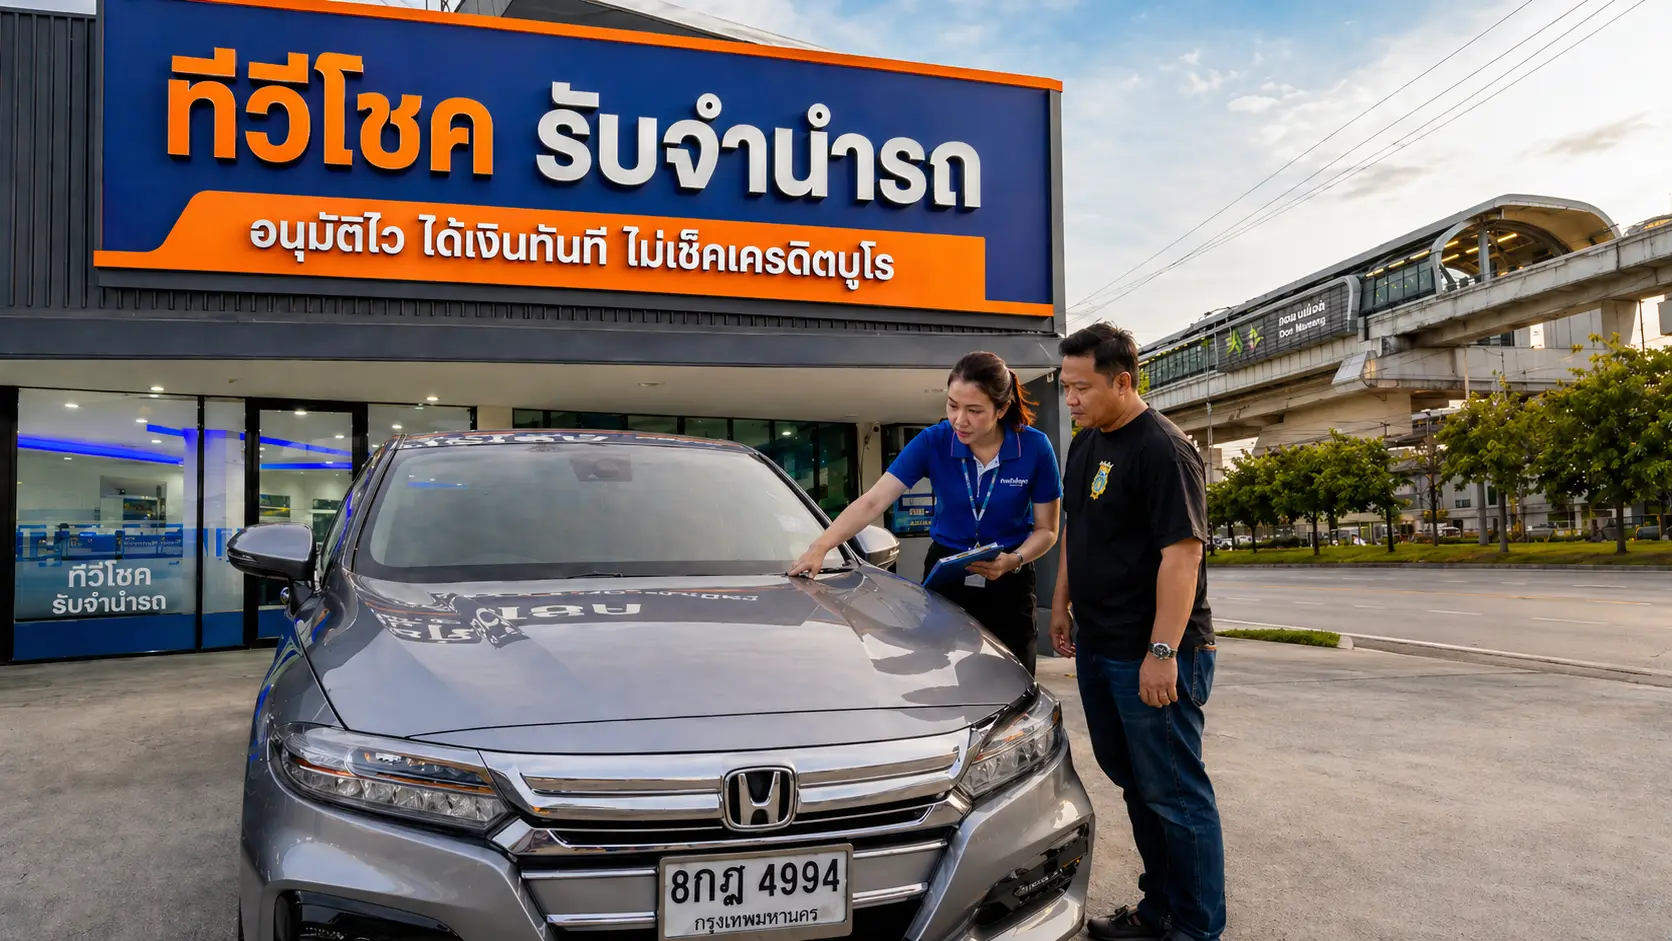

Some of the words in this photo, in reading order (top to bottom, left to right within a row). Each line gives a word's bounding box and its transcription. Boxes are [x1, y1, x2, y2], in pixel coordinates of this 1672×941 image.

[167, 47, 493, 176] ทีวีโชค
[536, 81, 981, 208] รับจำนำรถ
[250, 211, 405, 263] อนุมัติไว
[418, 213, 608, 266] ได้เงินทันที
[623, 225, 895, 290] ไม่เช็คเครดิตบูโร
[68, 560, 152, 588] ทีวีโชค
[52, 590, 167, 615] รับจำนำรถ
[758, 859, 840, 898] 4994
[695, 908, 819, 934] กรุงเทพมหานคร
